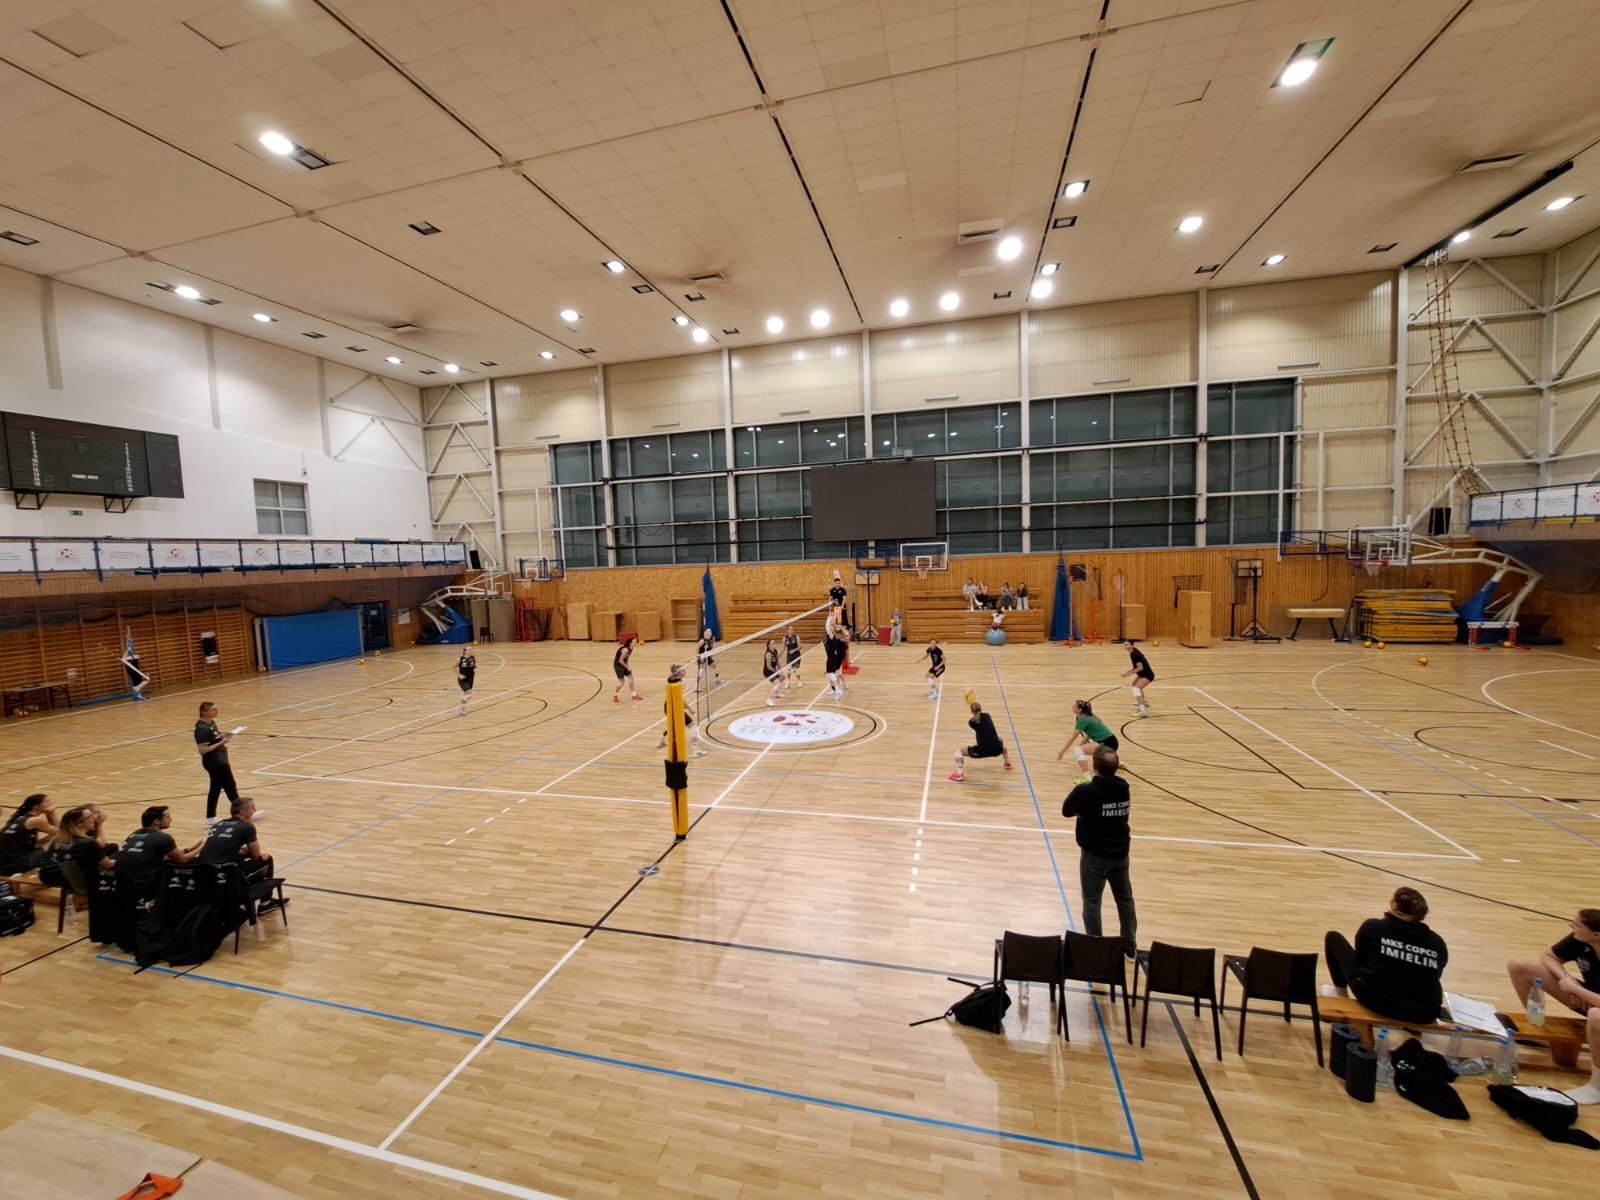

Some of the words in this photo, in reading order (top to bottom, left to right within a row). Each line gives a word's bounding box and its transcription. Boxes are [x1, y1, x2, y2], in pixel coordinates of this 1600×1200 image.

[1380, 936, 1404, 949] MKS
[1405, 943, 1438, 958] COPCO
[1380, 944, 1438, 969] IMIELIN
